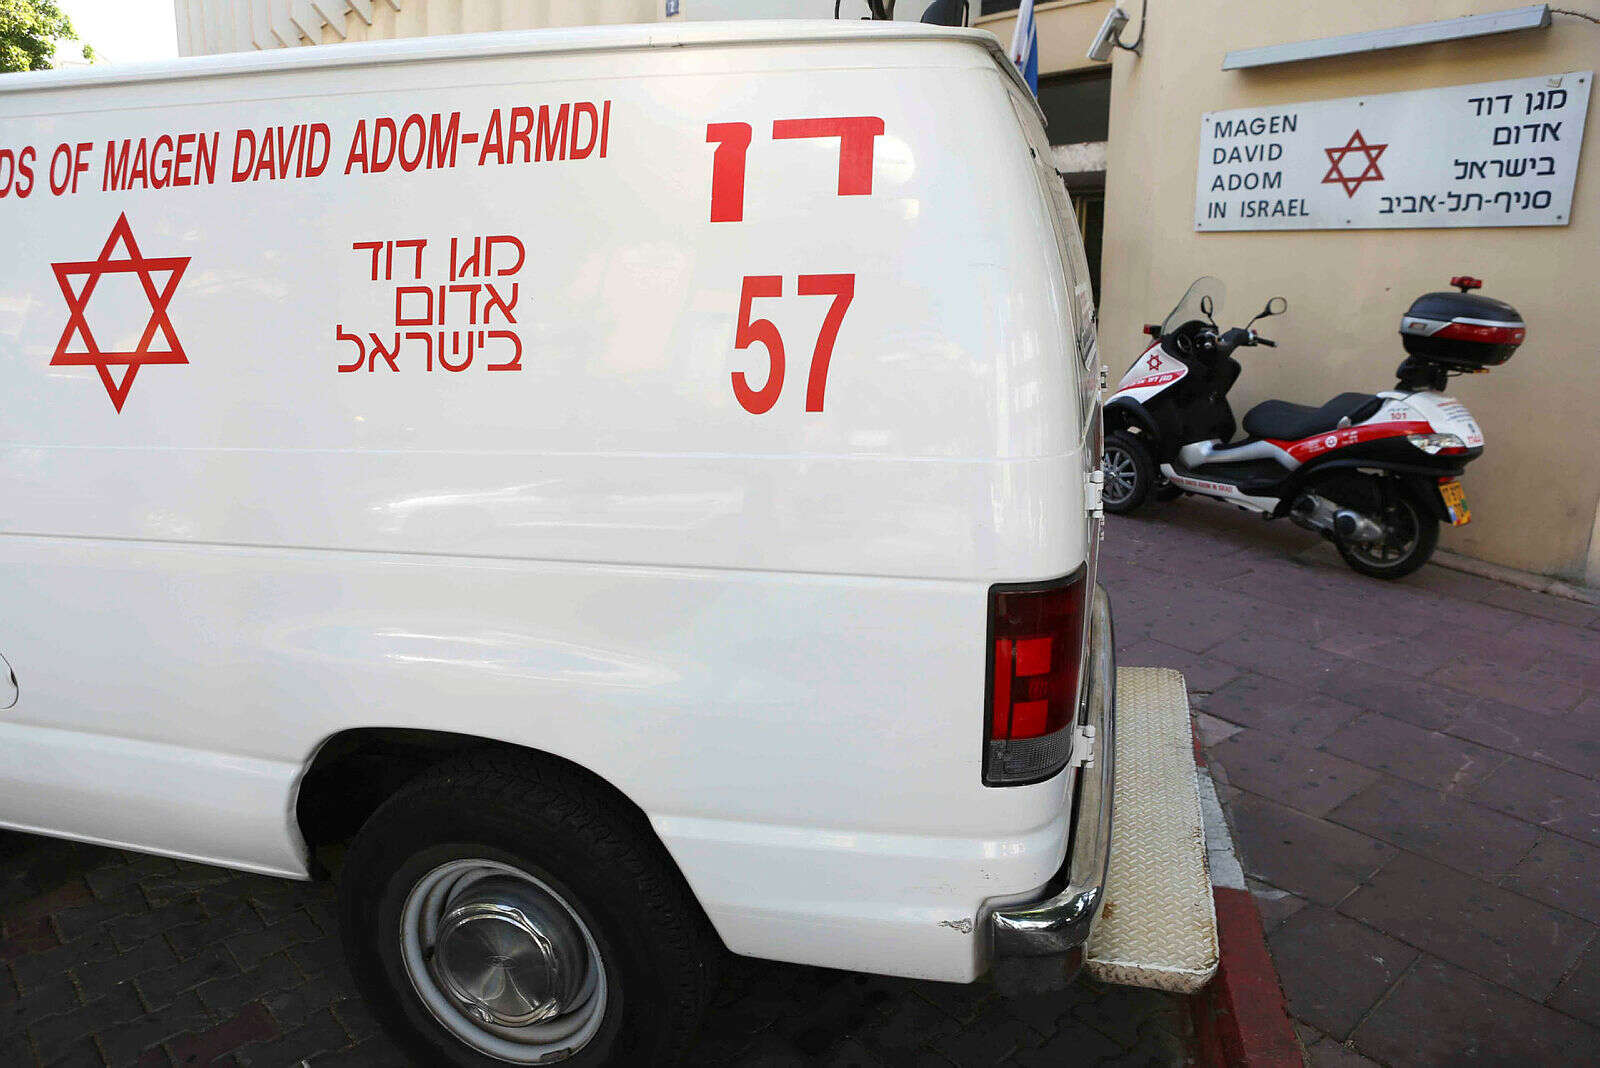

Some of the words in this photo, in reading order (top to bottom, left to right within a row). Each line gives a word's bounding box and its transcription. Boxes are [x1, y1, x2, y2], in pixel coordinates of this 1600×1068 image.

[1467, 95, 1513, 117] דוד
[1525, 89, 1568, 115] מגן
[1214, 114, 1297, 139] MAGEN
[1492, 121, 1563, 146] אדום
[49, 142, 94, 196] OF
[102, 131, 220, 193] MAGEN
[231, 122, 331, 183] DAVID
[344, 99, 611, 175] ADOM-ARMDI
[1213, 143, 1283, 165] DAVID
[705, 116, 885, 223] דן
[1211, 171, 1282, 192] ADOM
[1453, 156, 1556, 181] בישראל
[1207, 201, 1227, 219] IN
[1240, 198, 1309, 219] ISRAEL
[351, 238, 428, 281] דוד
[449, 235, 526, 282] מגן
[395, 282, 519, 327] אדום
[336, 324, 523, 373] בישראל
[730, 272, 856, 415] 57
